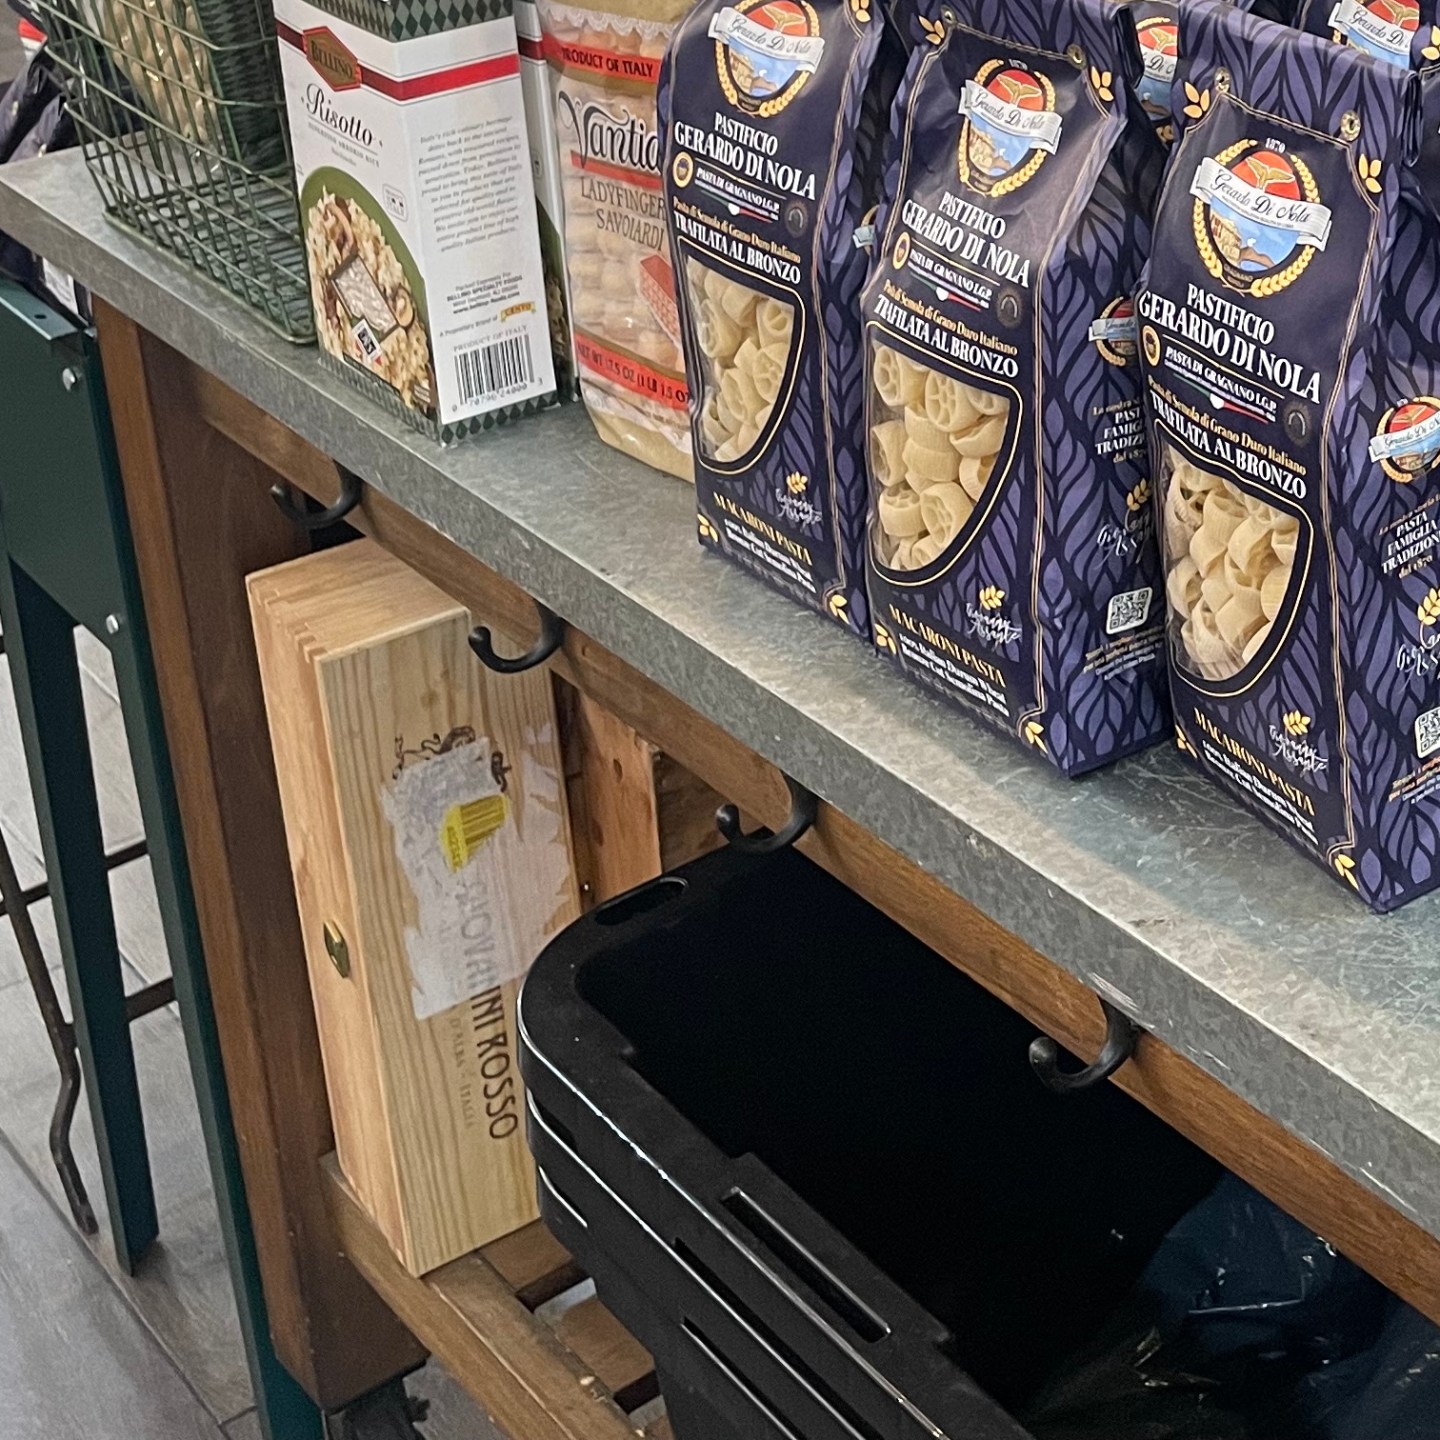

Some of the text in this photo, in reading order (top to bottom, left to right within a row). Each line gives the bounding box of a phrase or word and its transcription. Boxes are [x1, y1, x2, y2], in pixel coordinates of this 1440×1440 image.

[311, 40, 353, 80] BELLINO
[561, 47, 654, 77] PRODUCT OF ITALY
[306, 82, 373, 147] Risotto
[715, 112, 778, 156] PASTIFICIO
[674, 121, 816, 200] GERARDO DI NOLA
[1264, 137, 1286, 154] 1870
[938, 191, 1006, 240] PASTIFICIO
[1208, 170, 1311, 224] Gerardo Di Nola
[596, 210, 664, 251] SAVOIARDI
[674, 212, 801, 285] TRAFILATA BRONZO
[901, 199, 1031, 289] GERARDO DI NOLA
[453, 336, 491, 352] PRODUCT
[505, 324, 528, 337] ITALY
[1186, 283, 1275, 345] PASTIFICIO
[947, 338, 1019, 378] BRONZO
[1139, 290, 1321, 405] GERARDO DI NOLA
[1150, 390, 1307, 500] TRAFILATA BRONZO
[713, 491, 812, 566] MACARONI PASTA
[1387, 520, 1438, 557] FAMIGLIA
[1396, 511, 1428, 538] PASTA
[889, 604, 1006, 688] MACARONI PASTA
[1194, 707, 1315, 816] MACARONI PASTA
[476, 1035, 518, 1140] ROSSO
